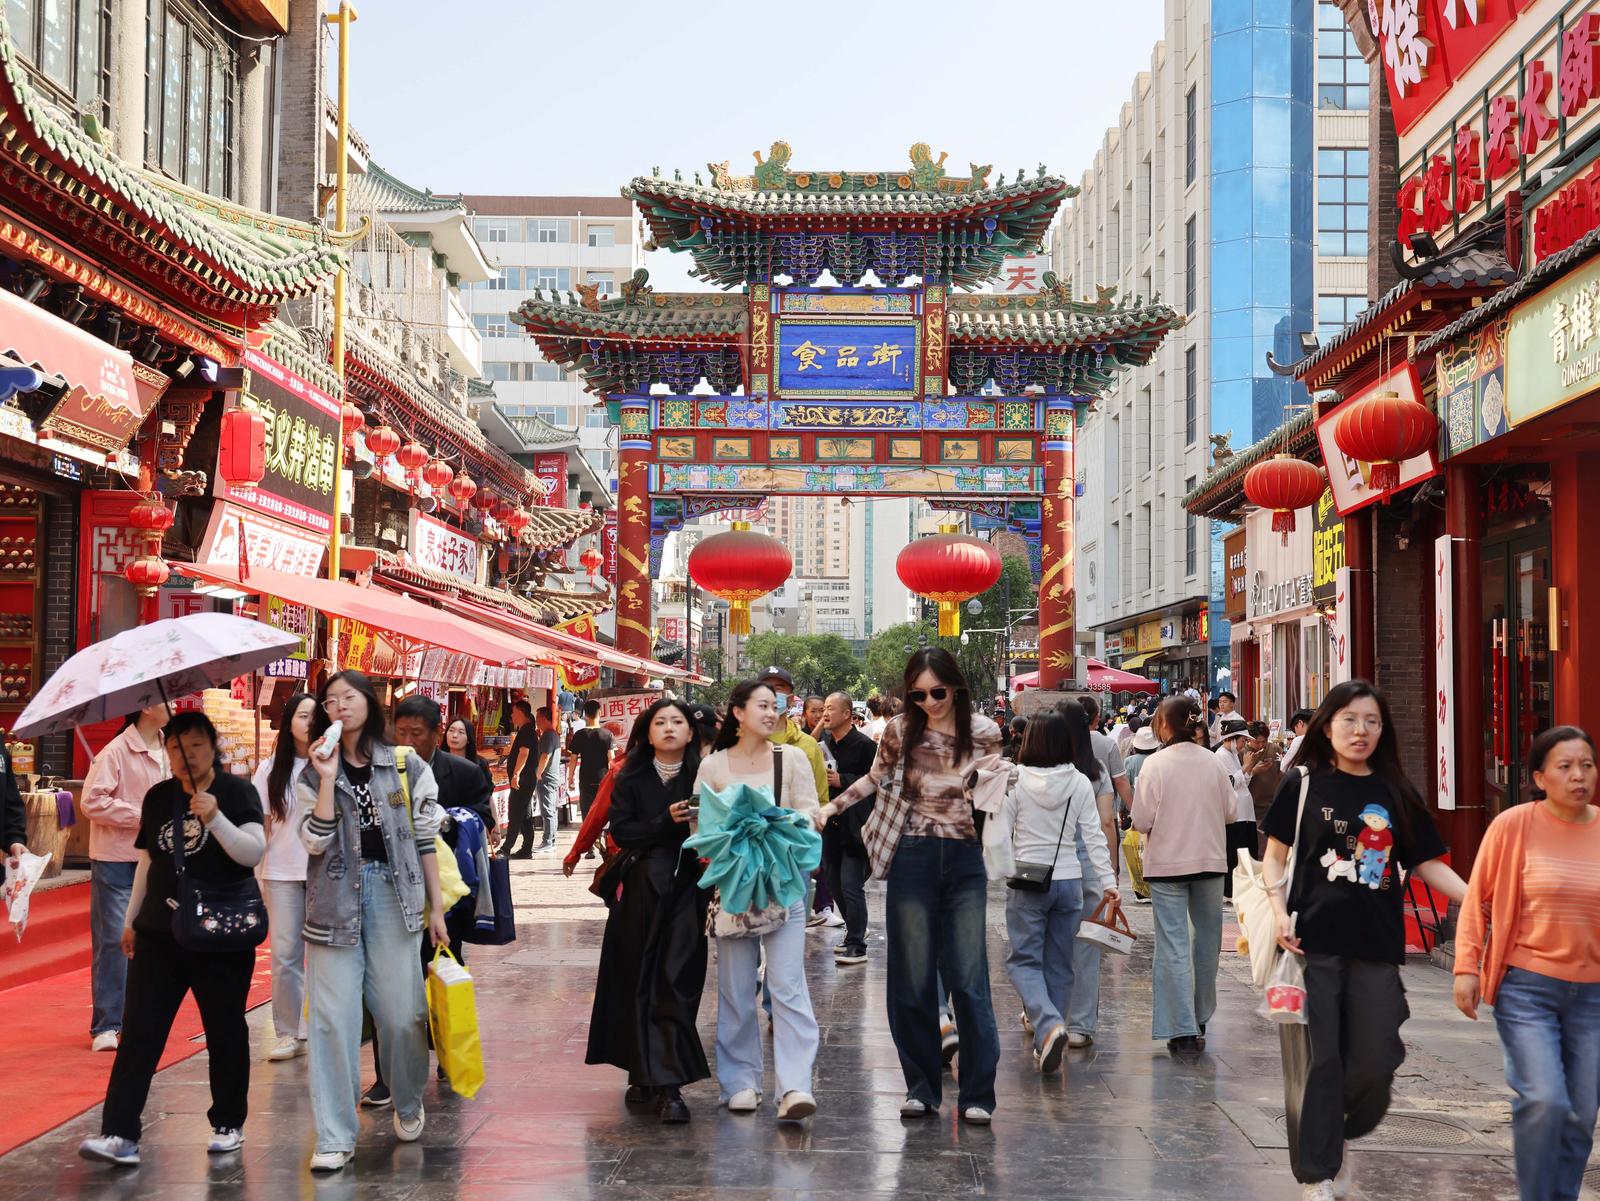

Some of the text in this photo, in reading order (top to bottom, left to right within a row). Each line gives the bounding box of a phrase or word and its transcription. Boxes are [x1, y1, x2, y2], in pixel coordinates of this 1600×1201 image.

[1549, 288, 1600, 363] 青稚
[792, 340, 902, 375] 食品街
[1314, 523, 1344, 588] 脆皮五
[1261, 578, 1297, 614] HEYTEA
[1299, 571, 1314, 604] 喜茶
